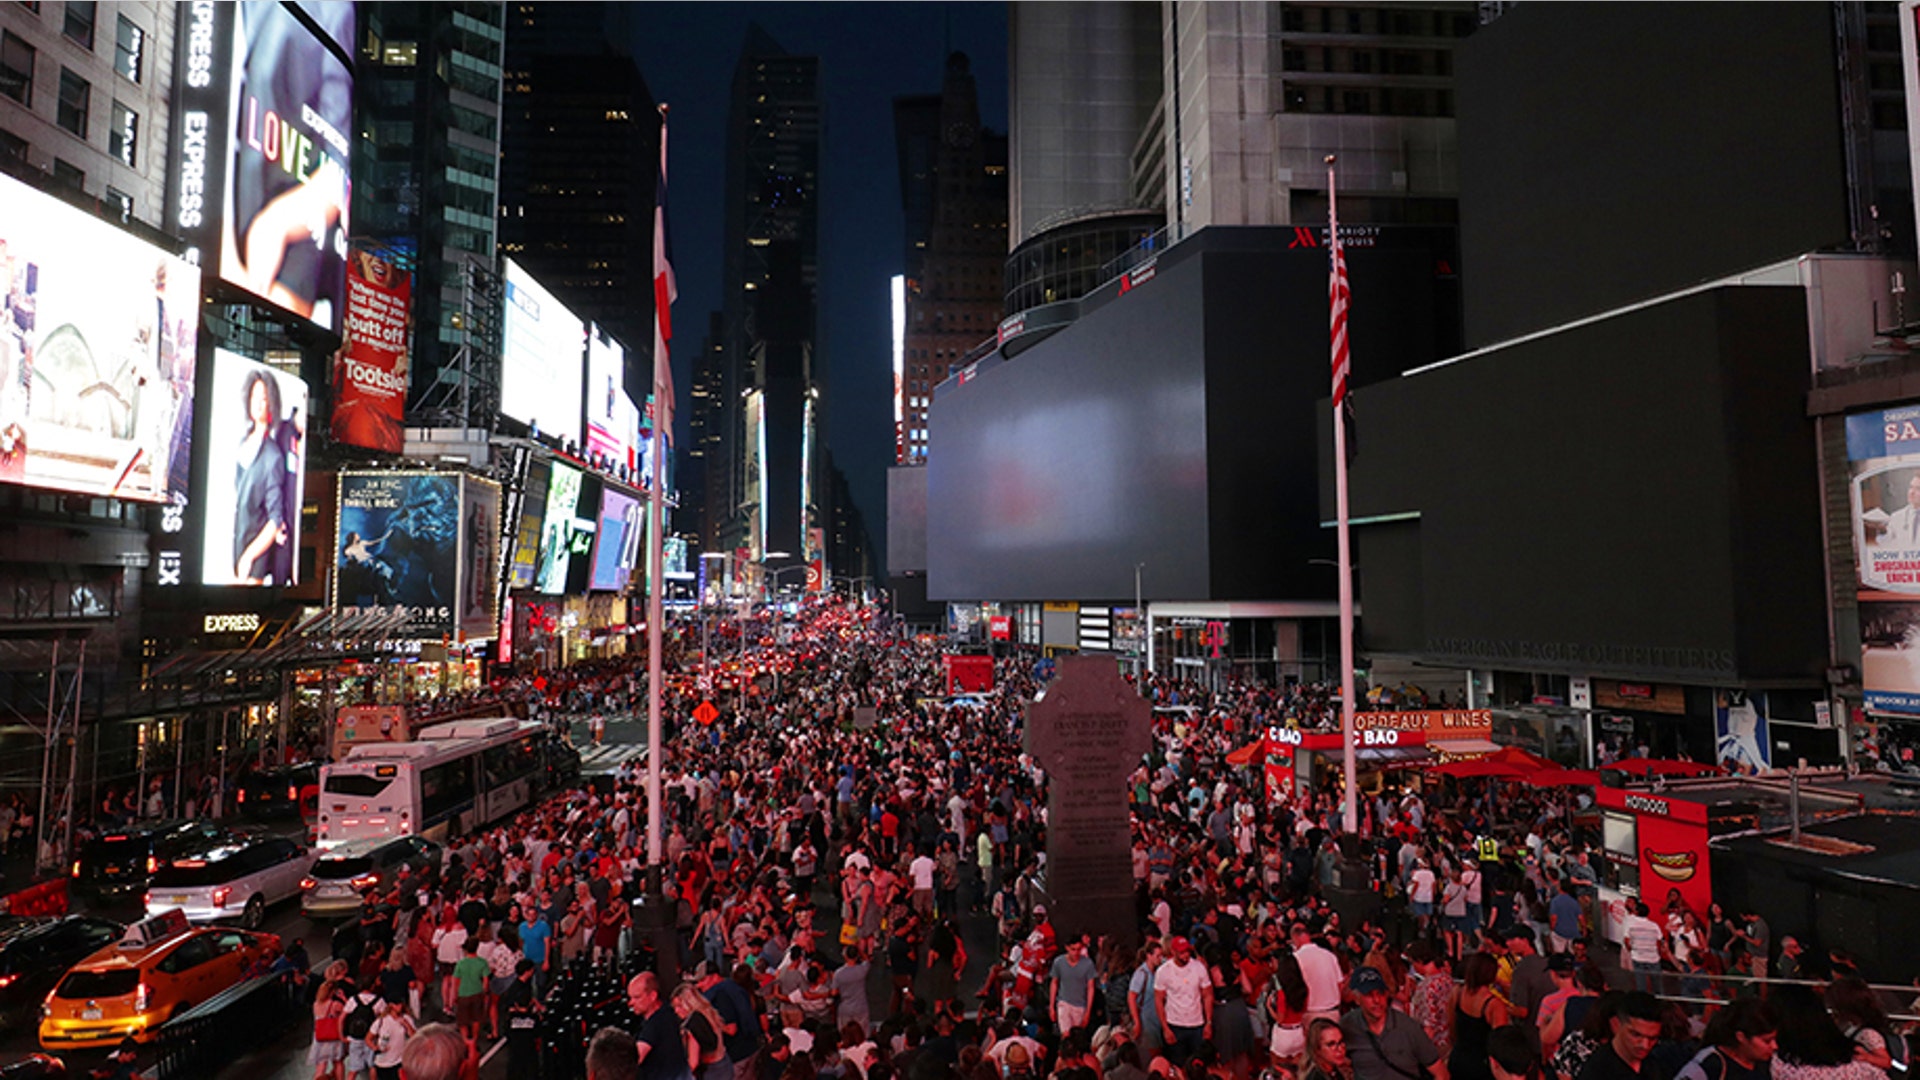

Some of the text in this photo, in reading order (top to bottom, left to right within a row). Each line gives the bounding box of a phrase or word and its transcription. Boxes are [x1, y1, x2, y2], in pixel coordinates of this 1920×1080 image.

[248, 97, 312, 185] LOVE
[179, 111, 208, 228] EXPRESS
[1321, 228, 1380, 236] MRRIOTT
[1322, 238, 1374, 246] MRQUIS
[349, 312, 404, 346] butt off
[344, 358, 404, 392] Tootsie
[1873, 551, 1900, 560] NOW
[204, 614, 261, 633] EXPRESS
[1424, 638, 1735, 672] AMERICAN EAGLE OUTFITTERS
[1355, 711, 1492, 730] ORDEAUX WINES
[1364, 730, 1398, 745] BAO
